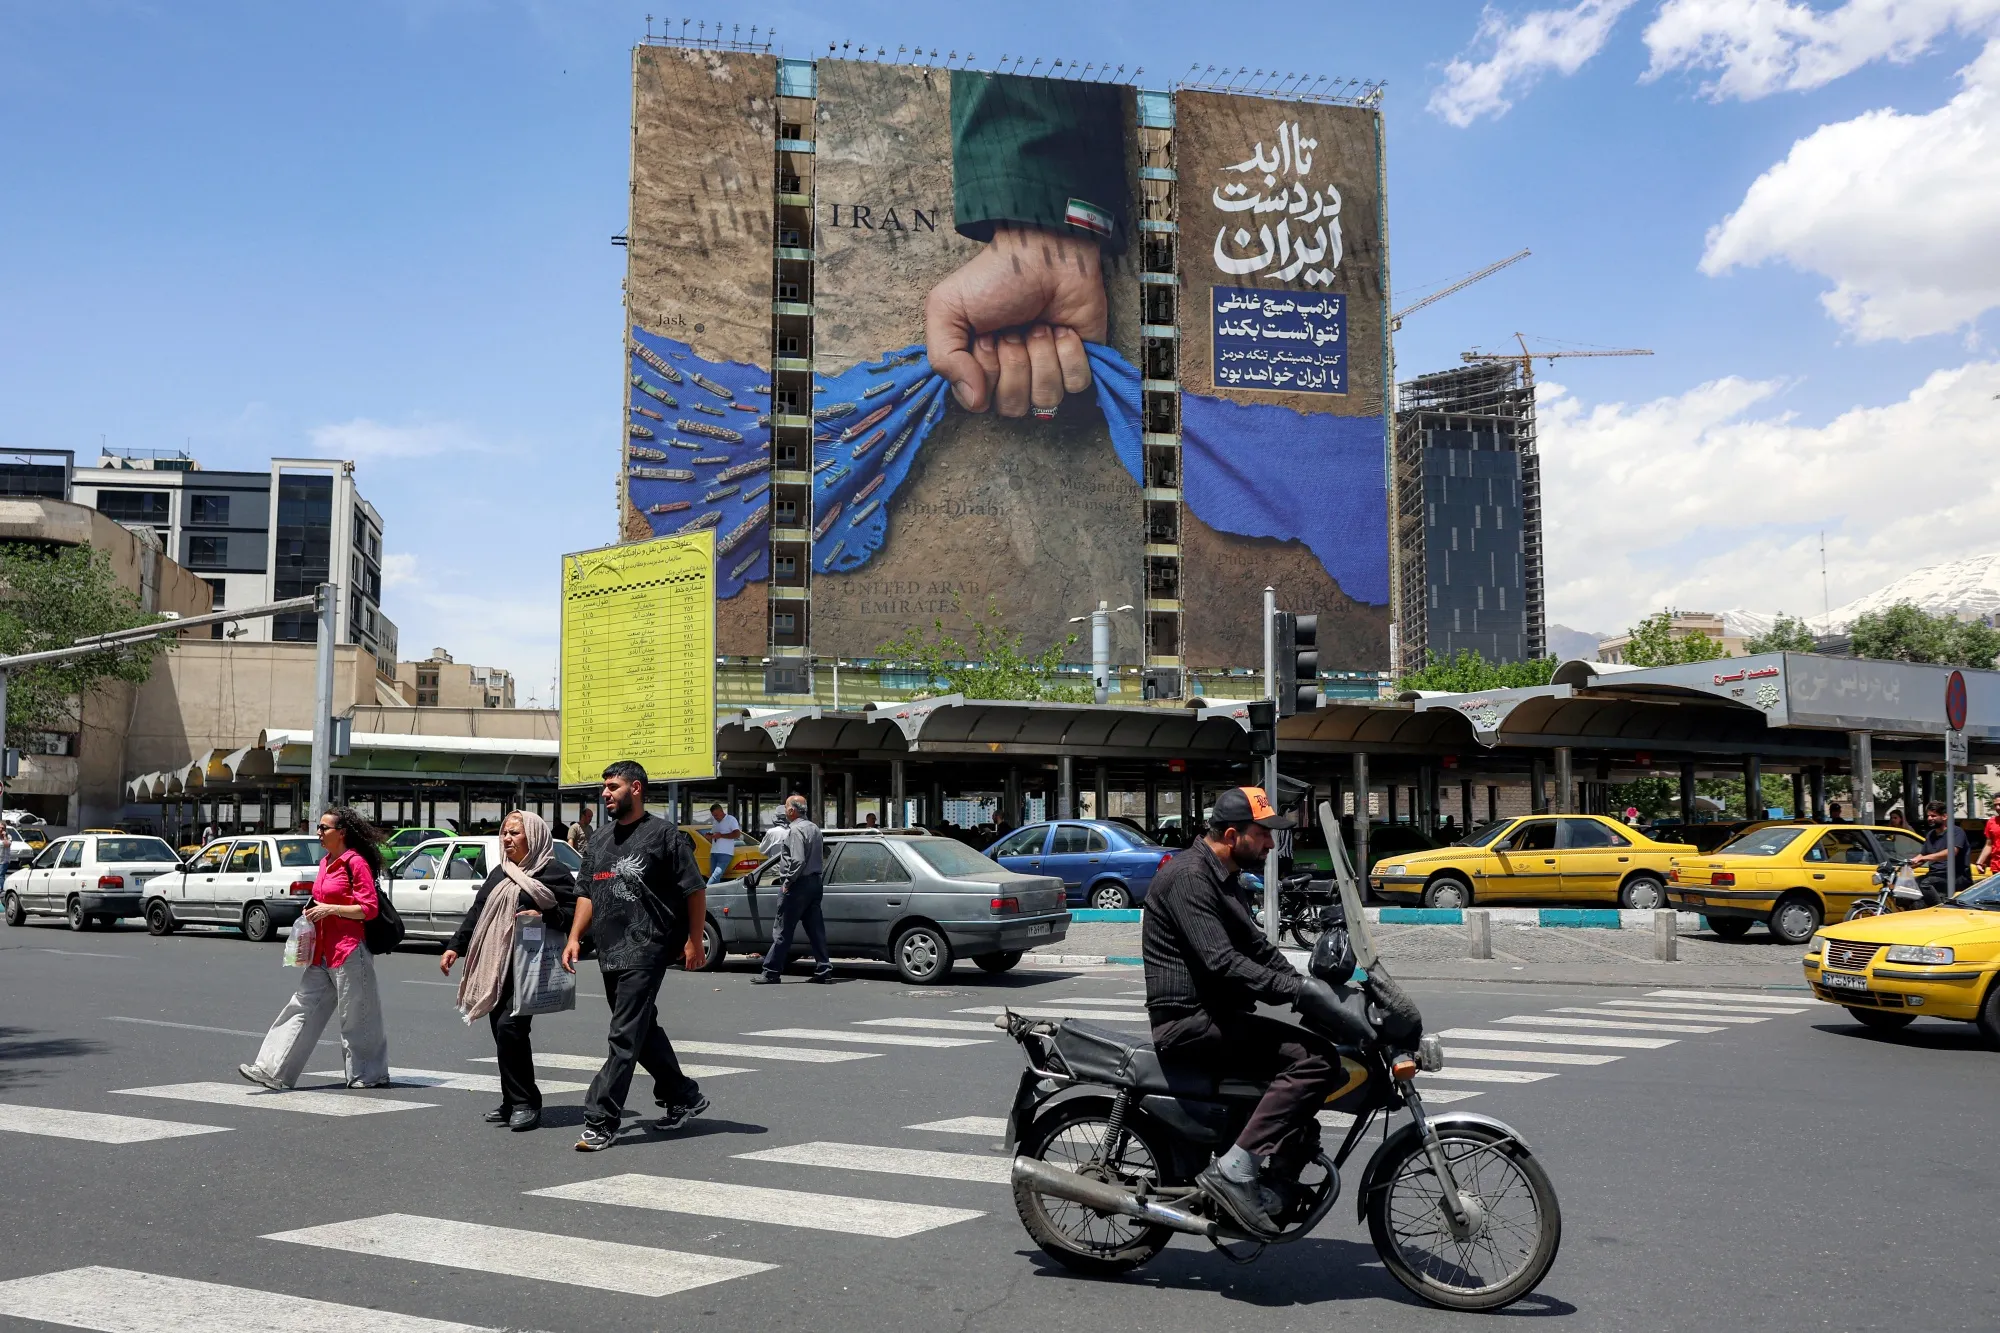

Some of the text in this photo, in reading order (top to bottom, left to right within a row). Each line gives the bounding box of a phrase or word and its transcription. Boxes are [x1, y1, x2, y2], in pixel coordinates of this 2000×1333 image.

[1218, 120, 1317, 187] تا ابد
[1213, 181, 1342, 223] در دست
[831, 203, 936, 233] IRAN
[1213, 216, 1343, 287] ایران
[1217, 293, 1340, 320] ترامپ هیچ غلطی
[657, 312, 686, 329] Jask
[1218, 319, 1340, 347] نتوانست بکند
[1220, 348, 1341, 366] کنترل همیشگی تنگه هرمز
[1219, 365, 1341, 390] با ایران خواهد بود
[943, 498, 1005, 519] Dhabi
[656, 543, 670, 553] حمل
[671, 540, 692, 550] معاونت
[630, 593, 647, 601] مقصد
[675, 583, 703, 593] شماره خط
[843, 580, 980, 597] UNITED ARAB
[581, 601, 597, 610] مسیر
[596, 598, 609, 608] طول
[861, 599, 961, 615] EMIRATES
[1283, 594, 1353, 613] Muscat
[1713, 665, 1780, 687] مقصد کرج
[644, 692, 655, 700] کرج
